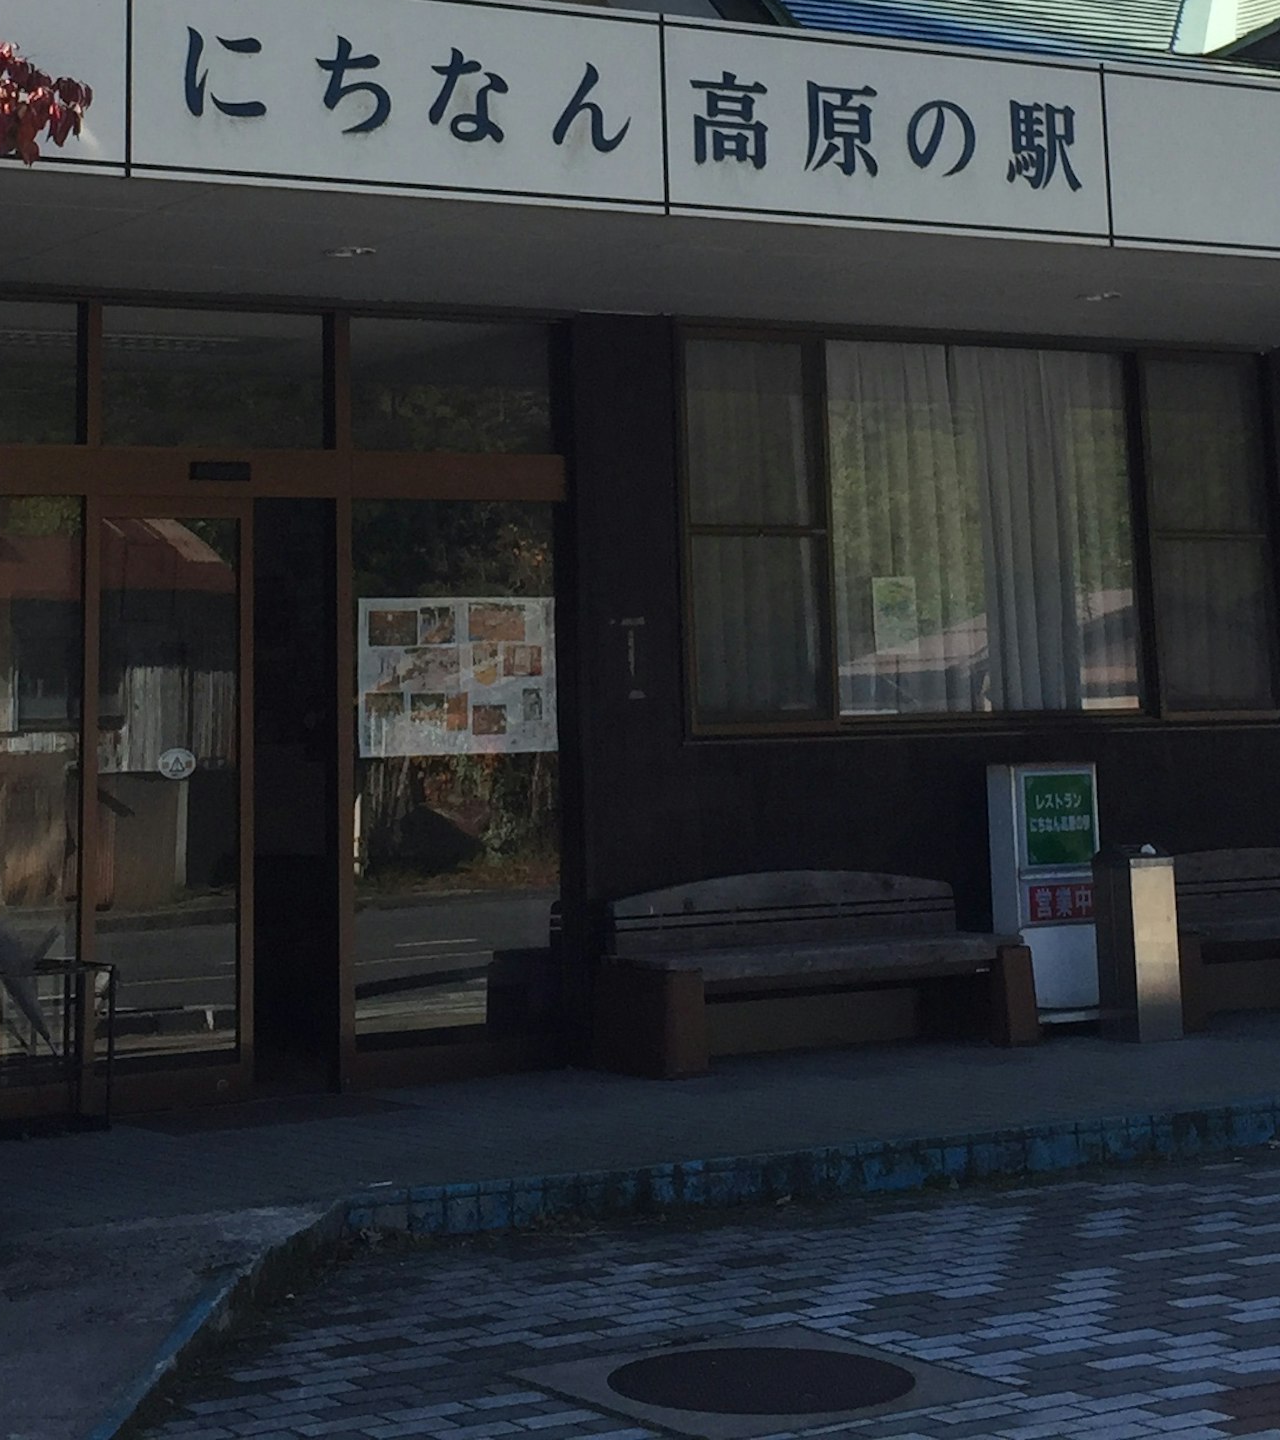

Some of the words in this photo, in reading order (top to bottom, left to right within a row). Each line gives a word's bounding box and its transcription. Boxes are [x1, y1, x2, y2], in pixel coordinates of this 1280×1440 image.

[1035, 792, 1082, 811] レストラン
[1035, 886, 1093, 919] 営業中
